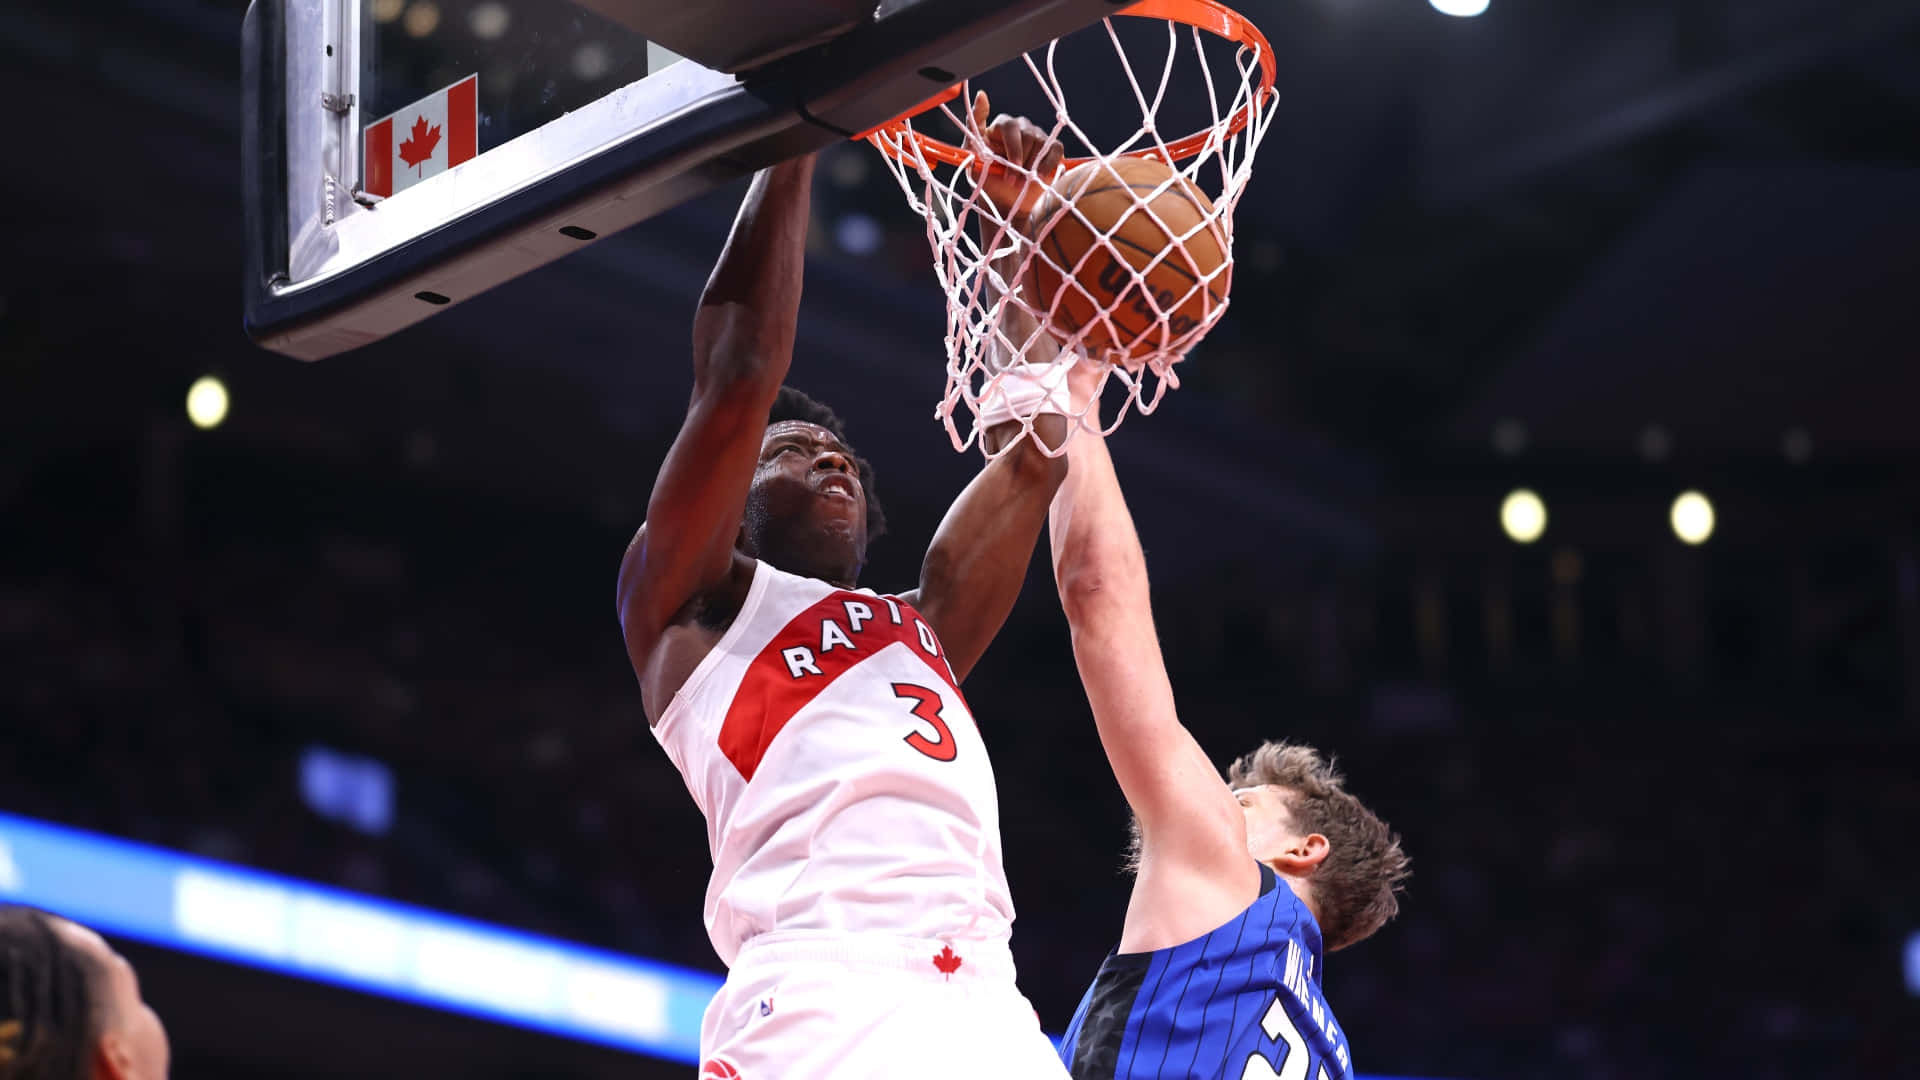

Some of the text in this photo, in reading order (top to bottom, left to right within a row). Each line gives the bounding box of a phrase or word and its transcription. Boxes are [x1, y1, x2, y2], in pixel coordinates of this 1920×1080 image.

[781, 598, 958, 687] RAPTO
[890, 682, 958, 762] 3
[1240, 996, 1330, 1080] 2
